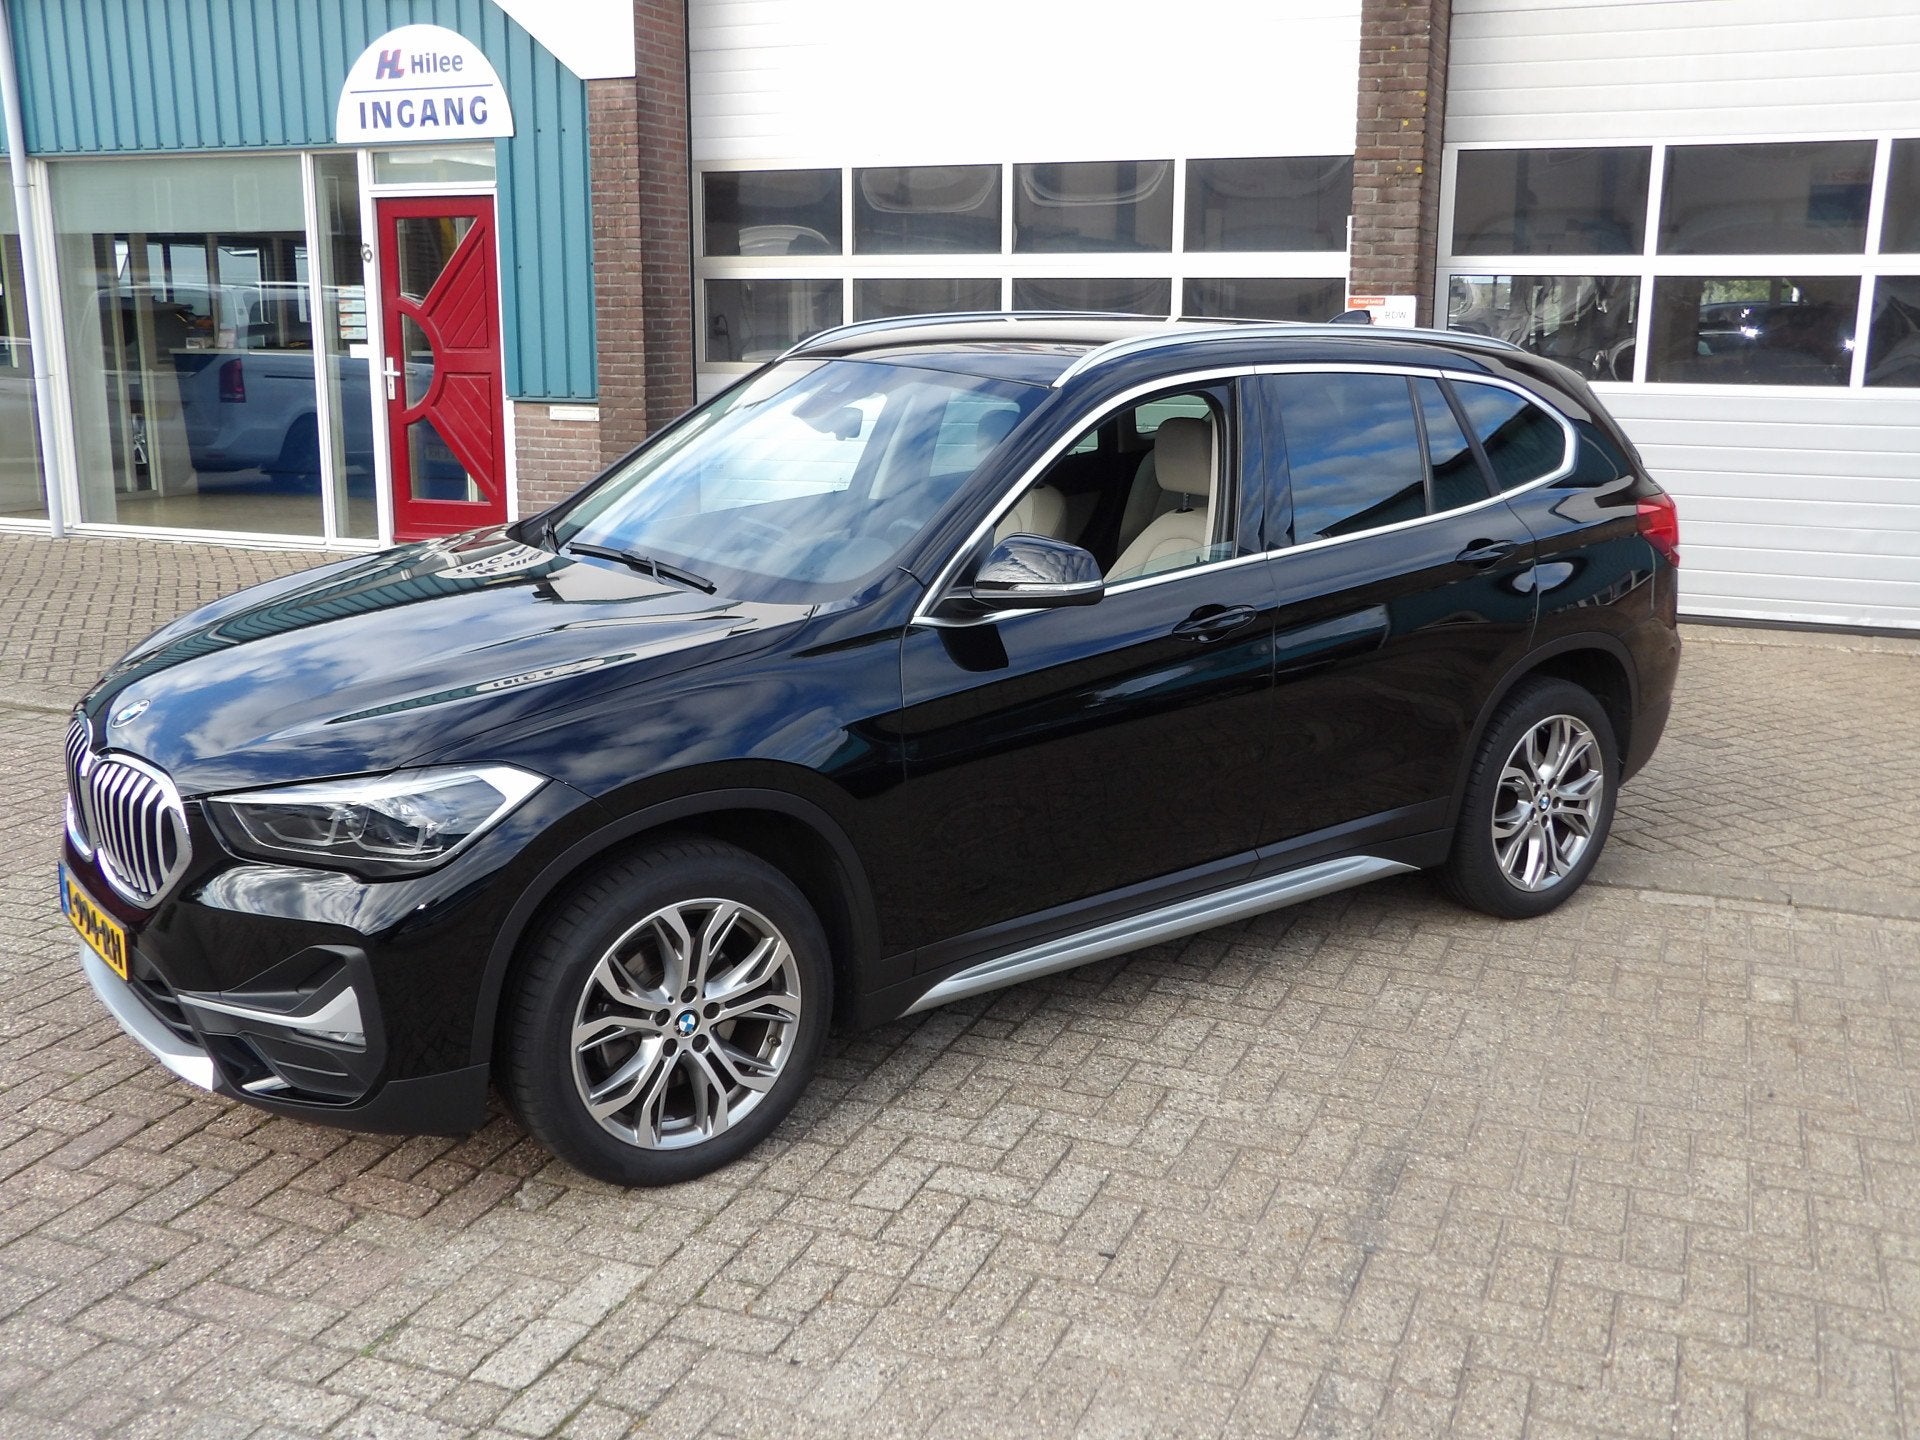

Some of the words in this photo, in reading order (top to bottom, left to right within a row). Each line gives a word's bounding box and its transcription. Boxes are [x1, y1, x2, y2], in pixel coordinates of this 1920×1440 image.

[410, 52, 463, 74] Hilee
[359, 96, 488, 130] INGANG
[360, 242, 373, 263] 6
